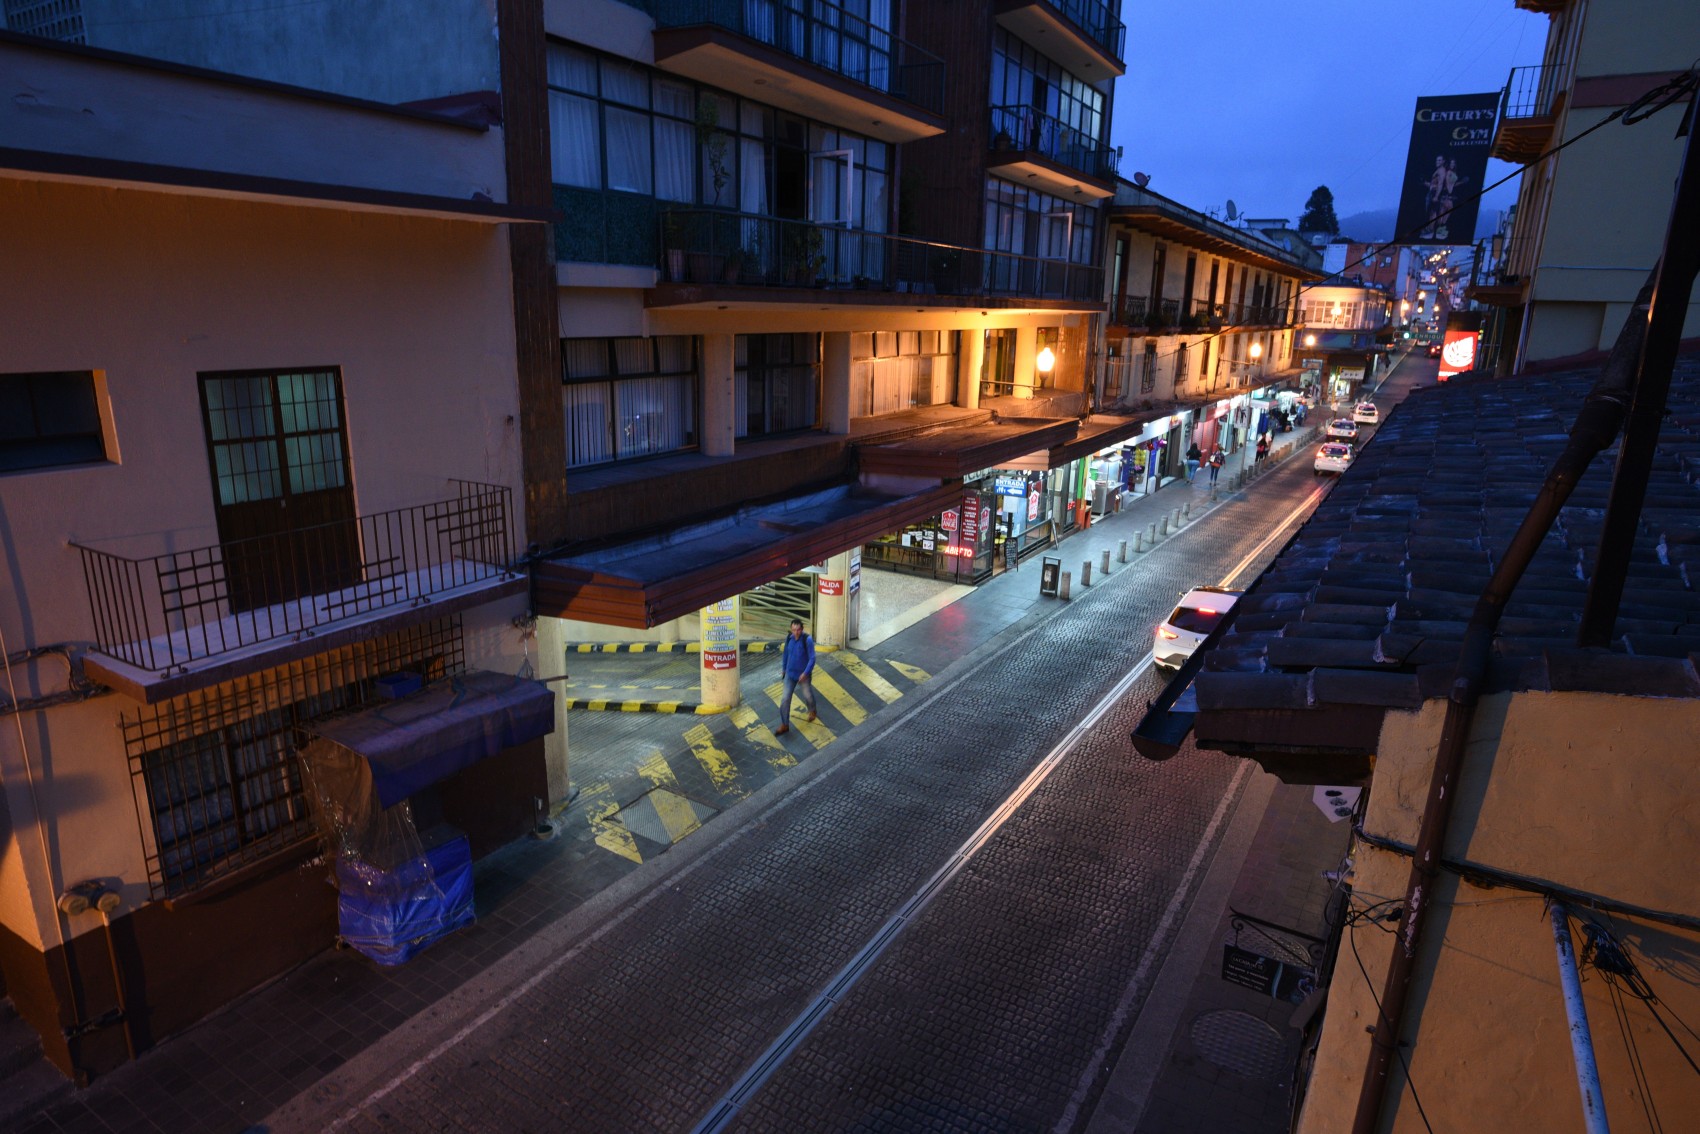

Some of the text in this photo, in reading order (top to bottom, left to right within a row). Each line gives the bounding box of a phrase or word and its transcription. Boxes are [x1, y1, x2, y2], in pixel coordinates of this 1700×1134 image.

[1416, 108, 1495, 122] CENTURY'S
[1452, 126, 1490, 140] GYM
[995, 478, 1025, 487] ENTRADA
[819, 579, 840, 588] SALIDA
[704, 653, 736, 661] ENTRADA
